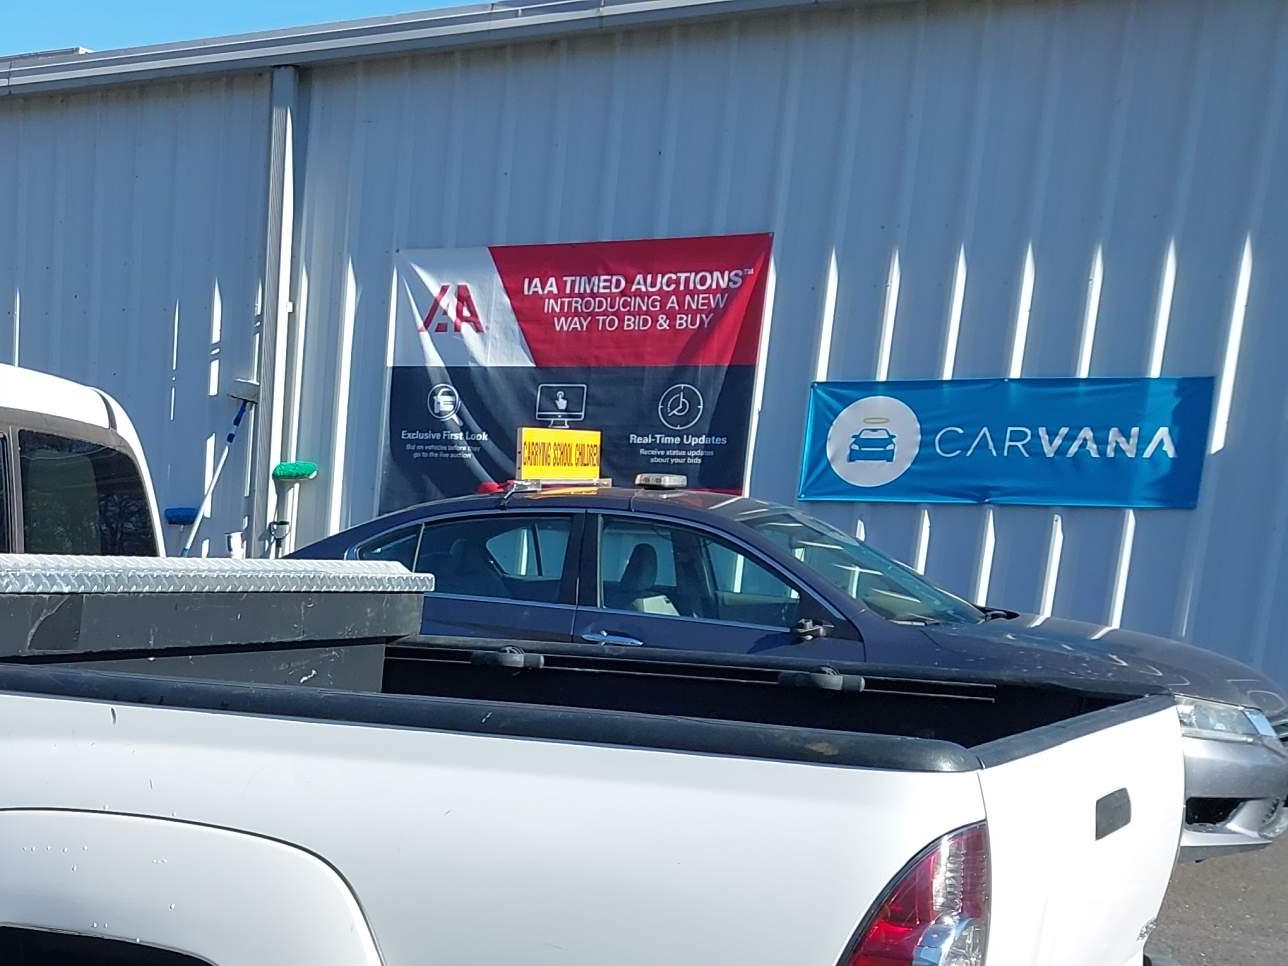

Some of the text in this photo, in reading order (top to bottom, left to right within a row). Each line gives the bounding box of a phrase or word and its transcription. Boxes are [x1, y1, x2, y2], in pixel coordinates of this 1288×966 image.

[523, 276, 558, 295] IAA
[562, 274, 626, 294] TIMED
[544, 293, 728, 313] INTRODUCING A NEW
[553, 313, 713, 332] WAY TO BID & BUY
[401, 430, 488, 441] Exclusive First Look
[629, 434, 727, 446] Real-Time Updates
[934, 426, 1177, 458] CARVANA
[523, 441, 551, 467] CARRYING
[553, 441, 573, 467] SCHOOL
[639, 448, 665, 456] Receive
